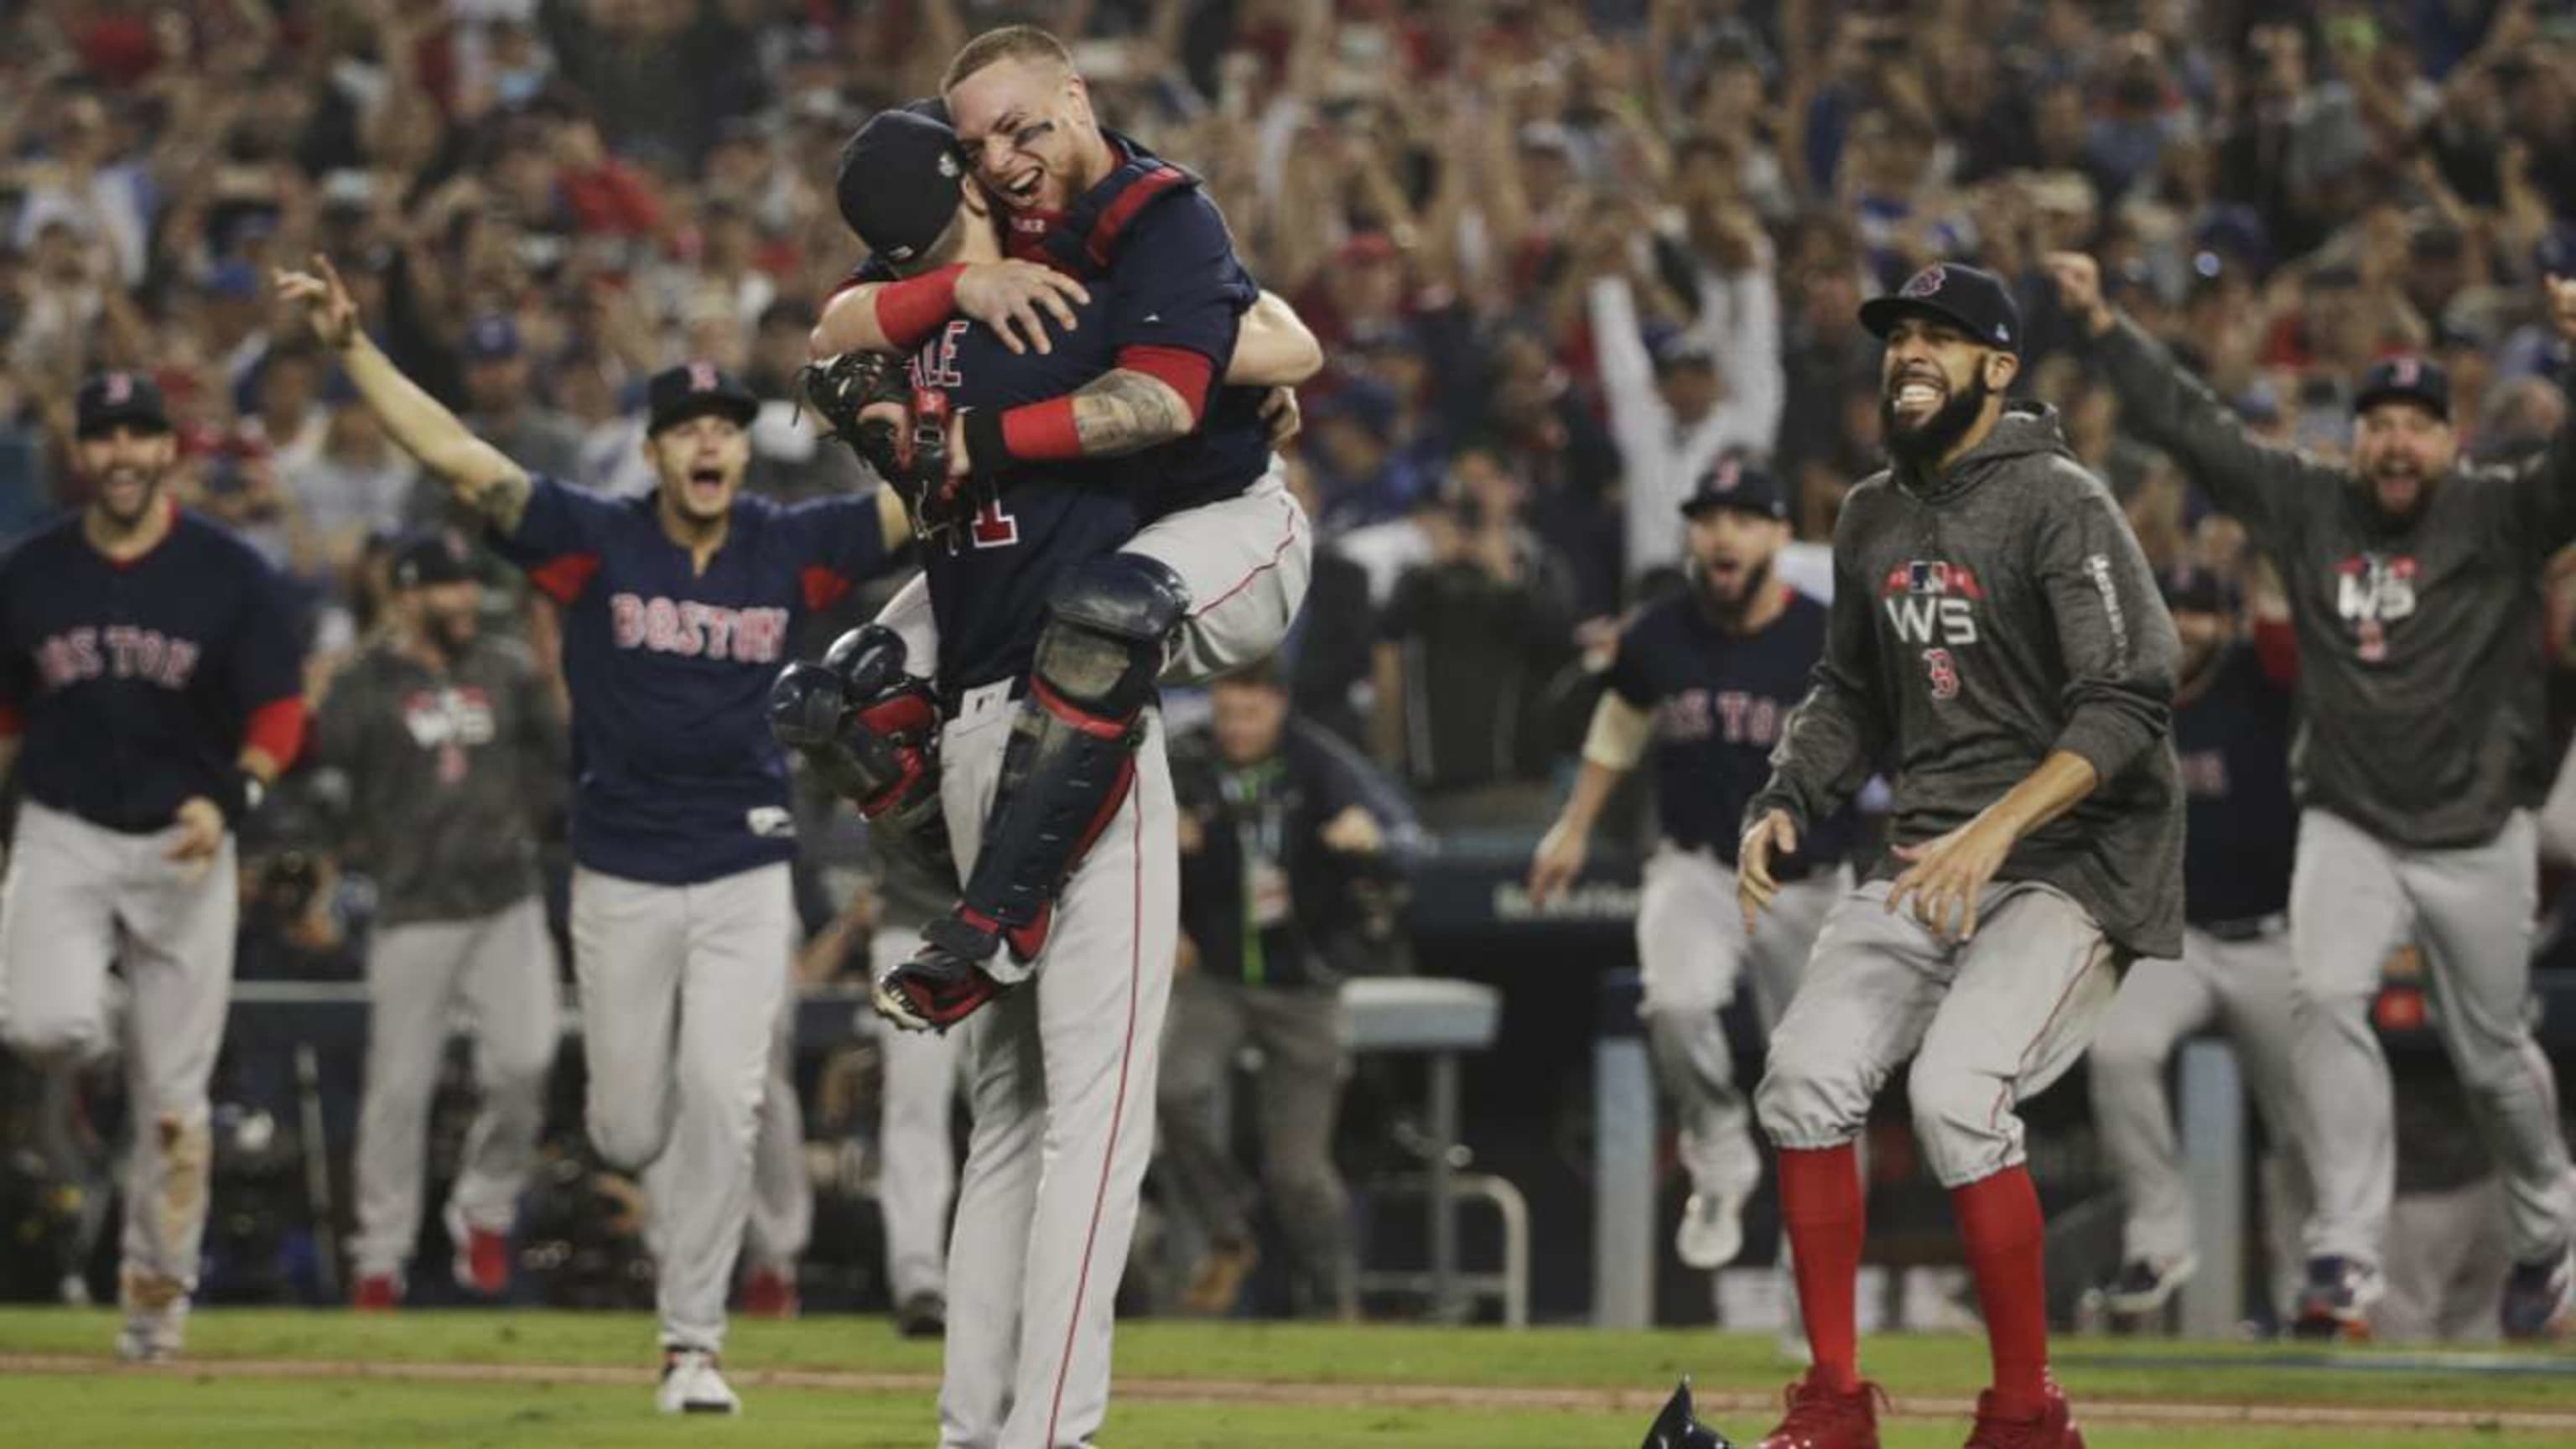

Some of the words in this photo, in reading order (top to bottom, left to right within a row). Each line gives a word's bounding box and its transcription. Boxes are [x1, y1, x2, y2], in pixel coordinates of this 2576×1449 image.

[610, 592, 789, 662] BOSTON
[1885, 597, 1978, 644] WS
[1921, 647, 1962, 699] B
